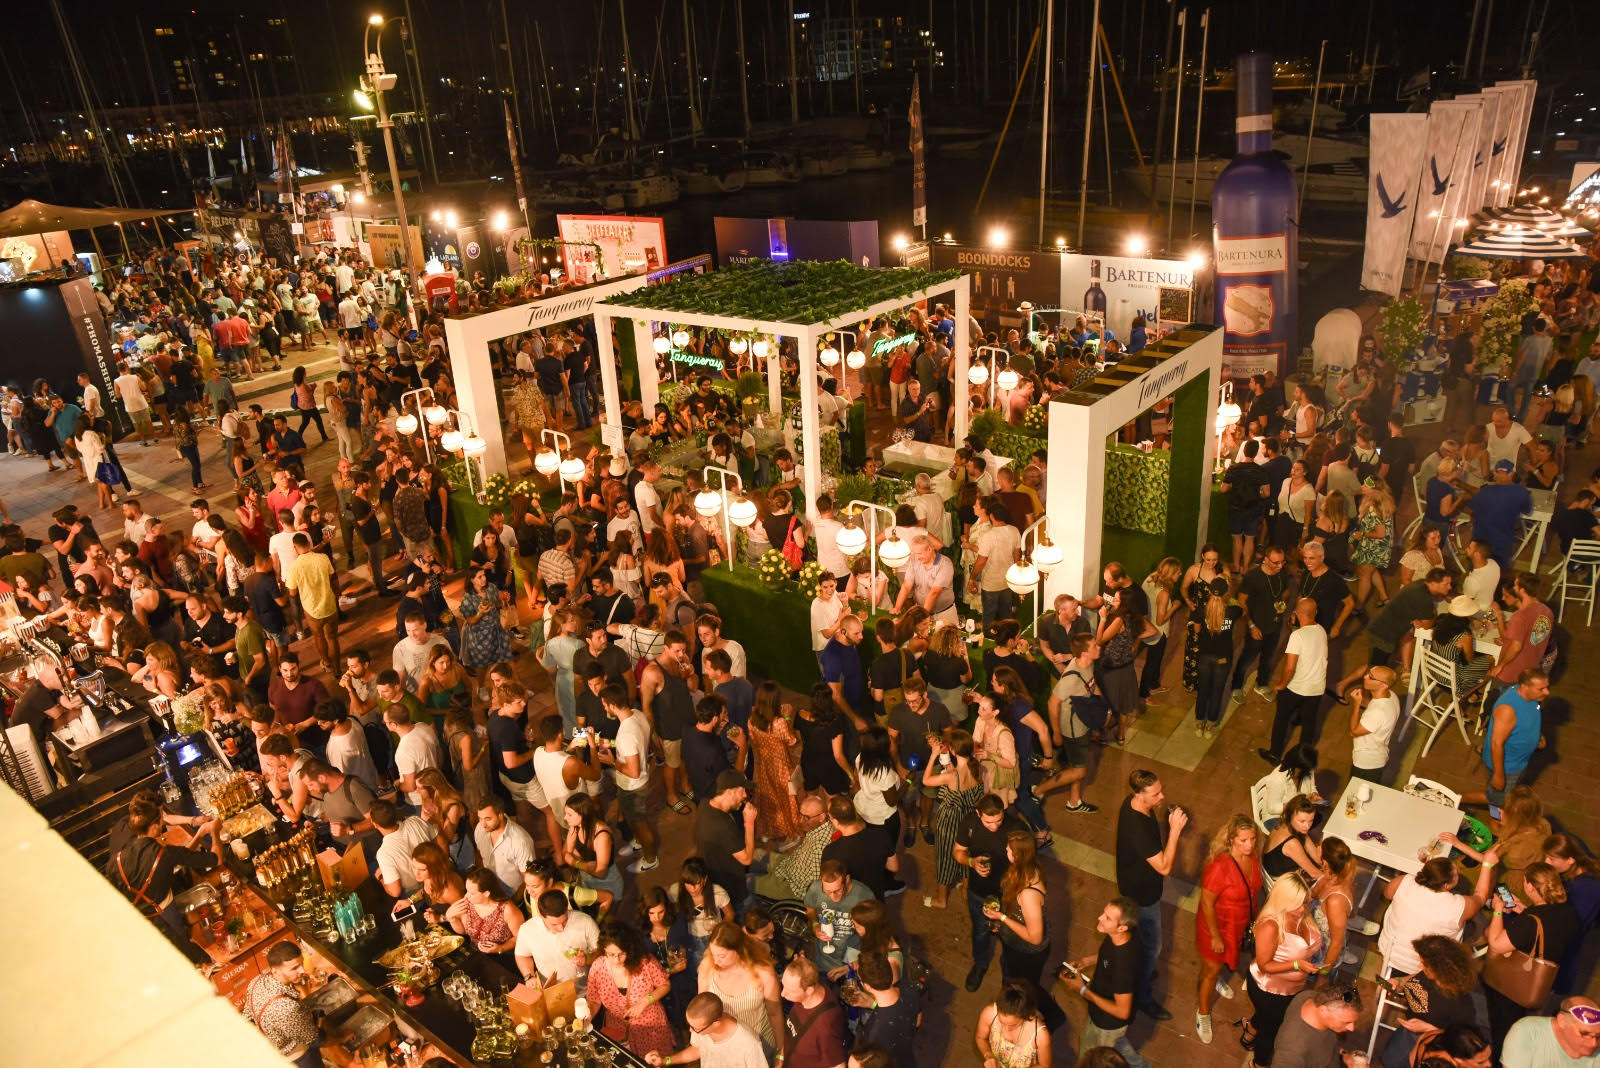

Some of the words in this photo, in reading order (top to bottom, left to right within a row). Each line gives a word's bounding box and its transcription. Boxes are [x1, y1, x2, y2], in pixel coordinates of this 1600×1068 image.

[958, 252, 1031, 268] BOONDOCKS
[1218, 248, 1282, 261] BARTENURA
[528, 296, 594, 327] Tanqueray
[84, 317, 118, 404] #THOMASHENRY
[669, 348, 724, 371] Tanqueray
[1137, 359, 1189, 409] Tanqueray
[221, 962, 248, 982] SIERRA
